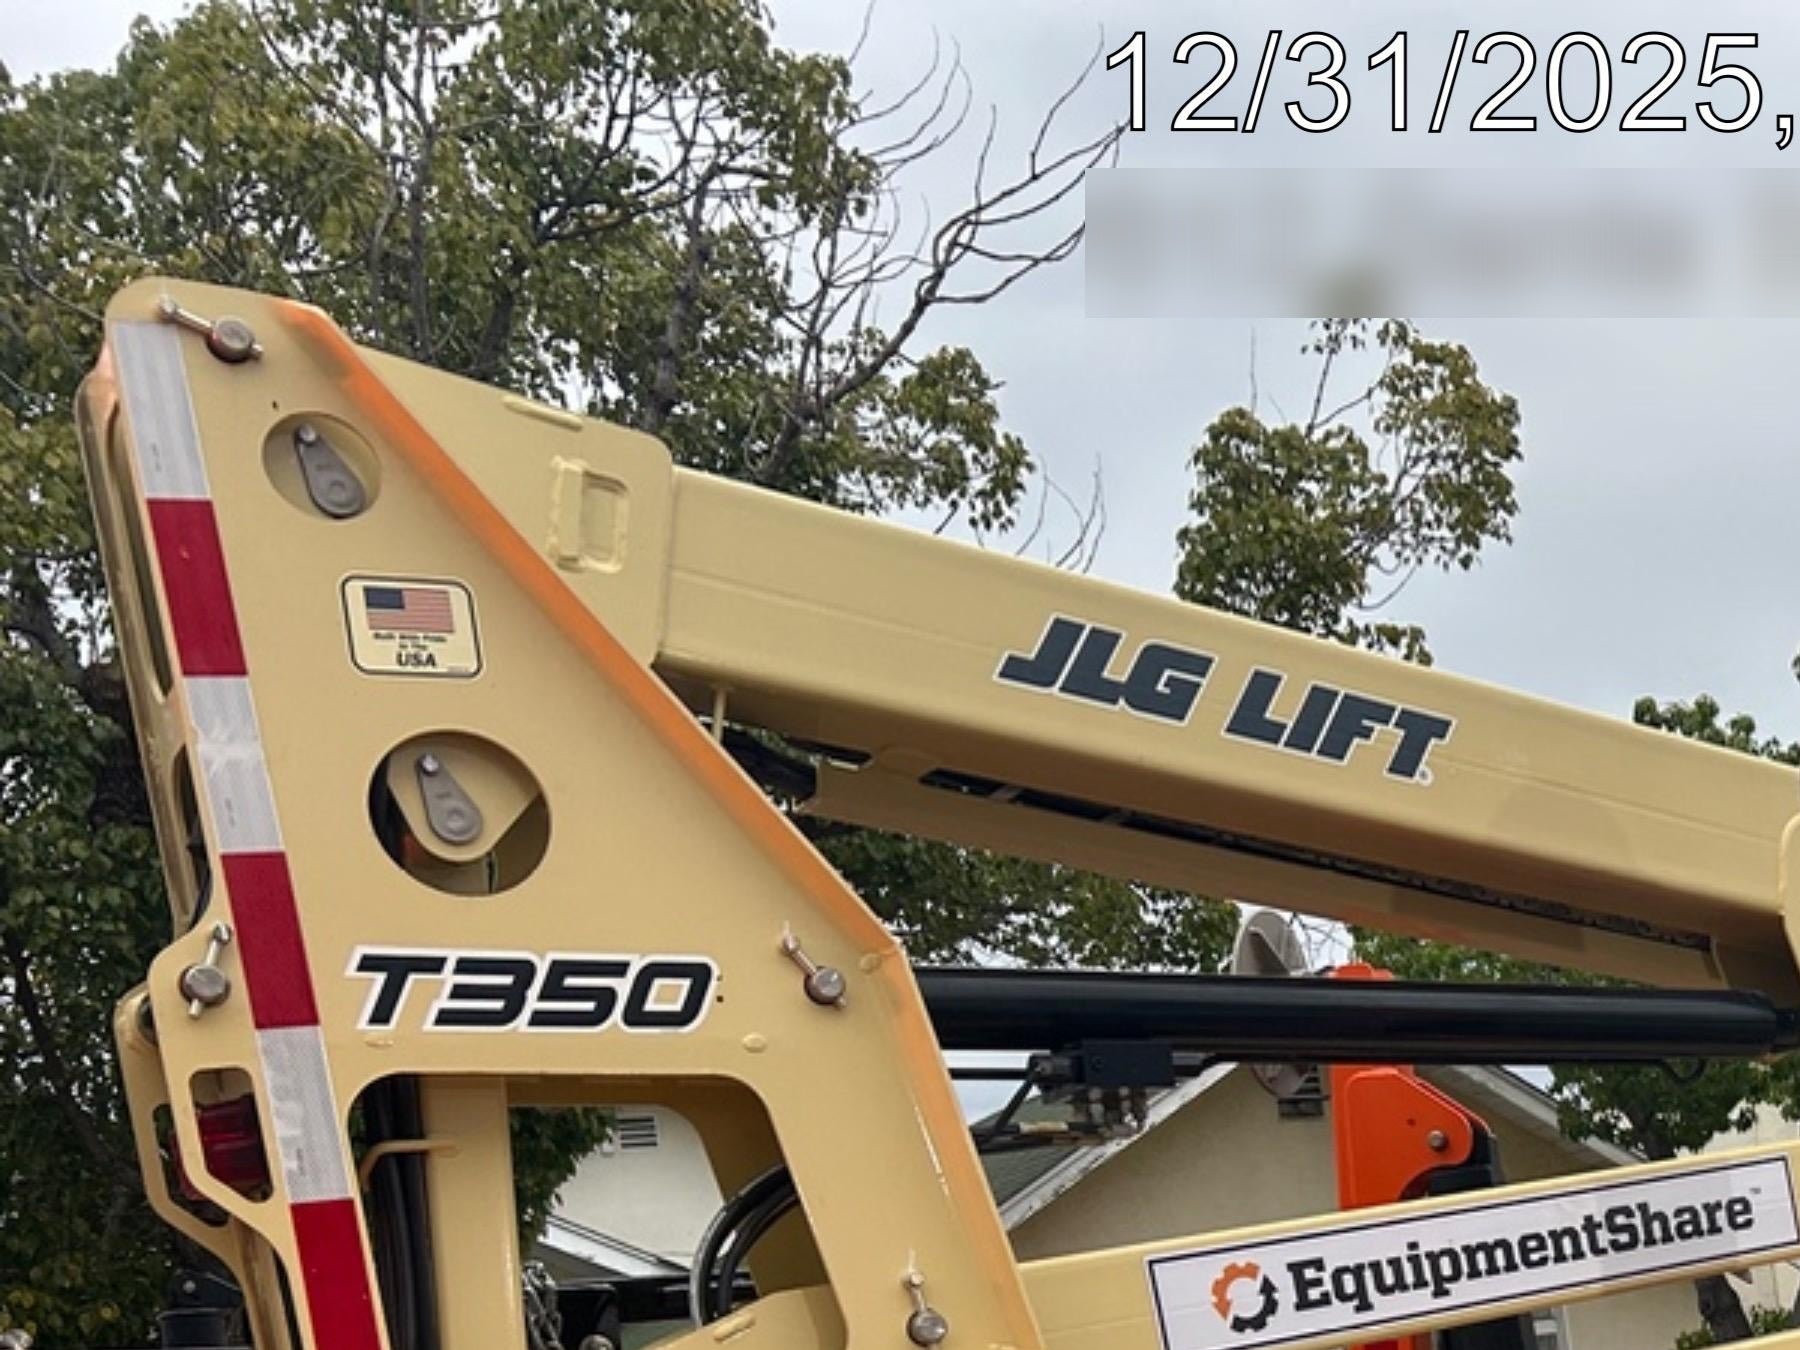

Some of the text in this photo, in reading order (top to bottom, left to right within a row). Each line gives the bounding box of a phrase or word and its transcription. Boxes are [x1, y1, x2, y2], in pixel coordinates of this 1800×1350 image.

[395, 651, 437, 669] USA
[993, 612, 1456, 782] JLG LIFT
[350, 948, 717, 1030] T350
[1284, 1194, 1755, 1313] EquipmentShare
